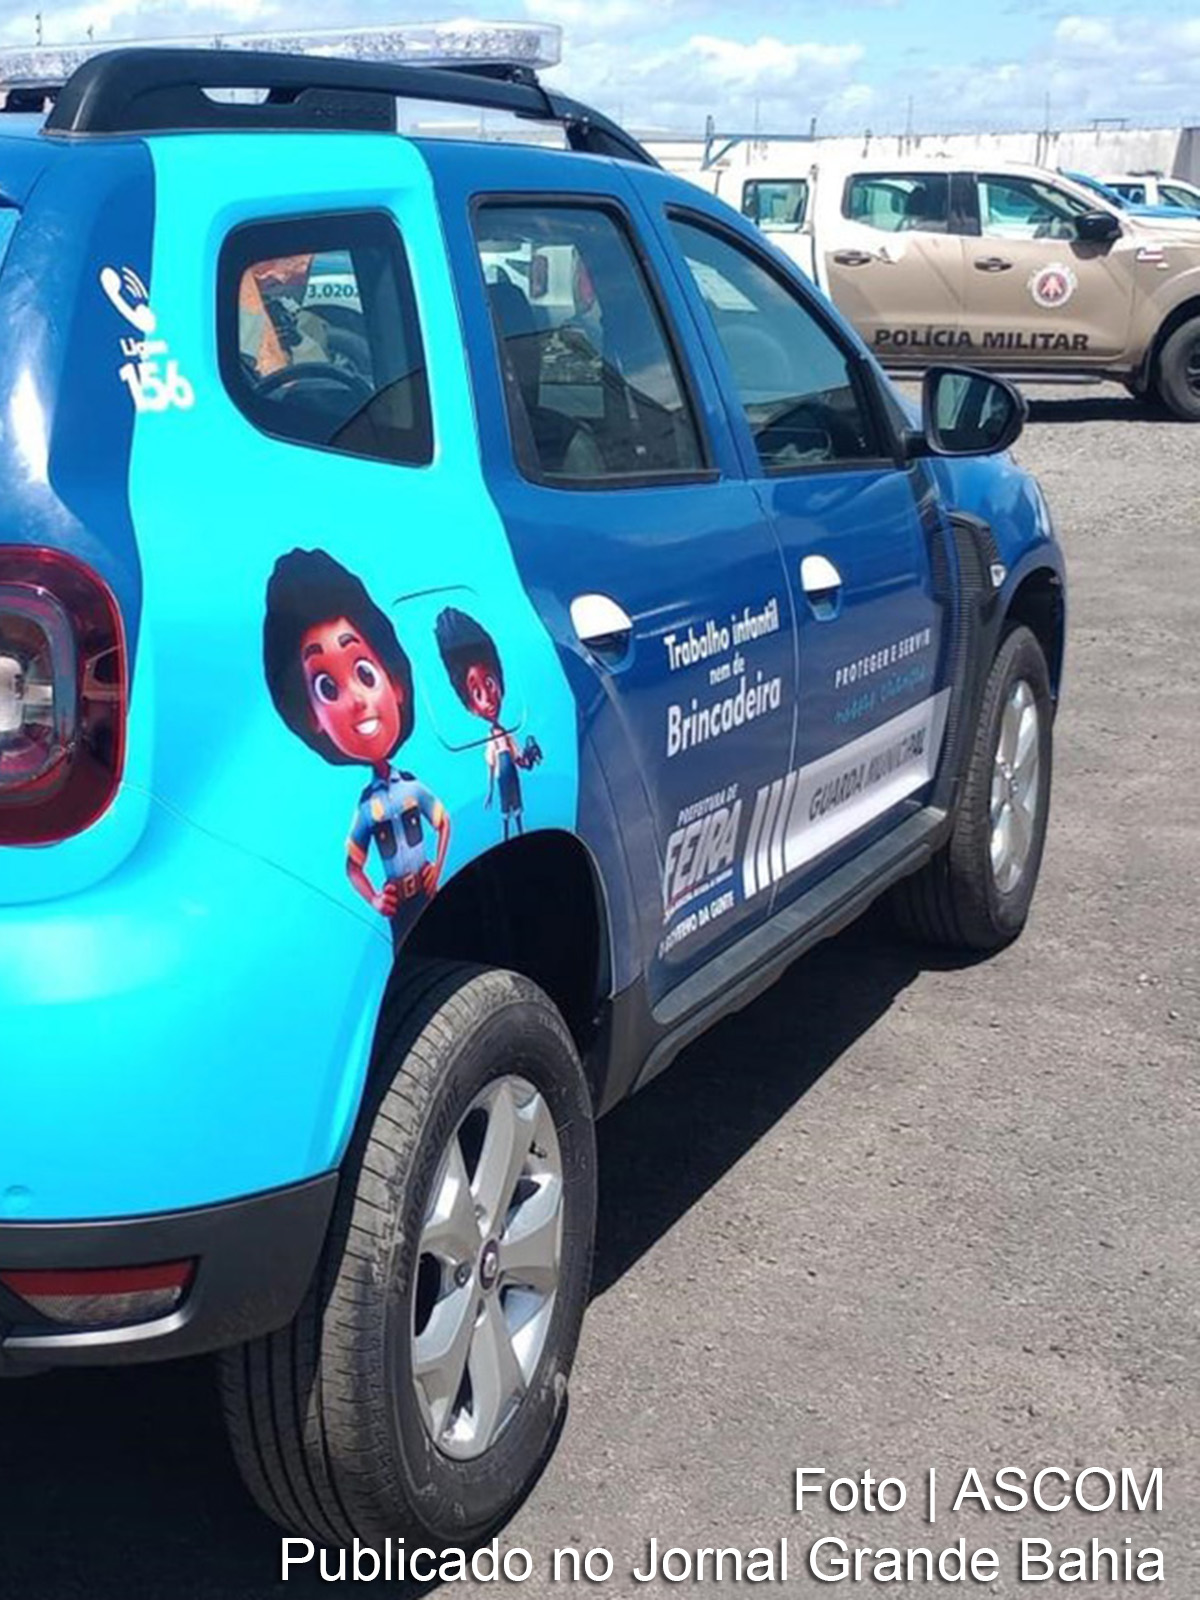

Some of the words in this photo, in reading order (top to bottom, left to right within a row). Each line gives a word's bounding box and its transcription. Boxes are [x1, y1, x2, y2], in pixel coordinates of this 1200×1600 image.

[875, 325, 973, 348] POLÍCIA
[982, 331, 1089, 351] MILITAR
[118, 360, 197, 413] 156
[663, 619, 730, 671] Trabalho
[731, 598, 780, 646] infantil
[709, 663, 732, 686] nem
[732, 651, 745, 676] de
[835, 648, 889, 690] PROTEGER
[667, 670, 781, 758] Brincadeira
[663, 799, 743, 913] FEIRA
